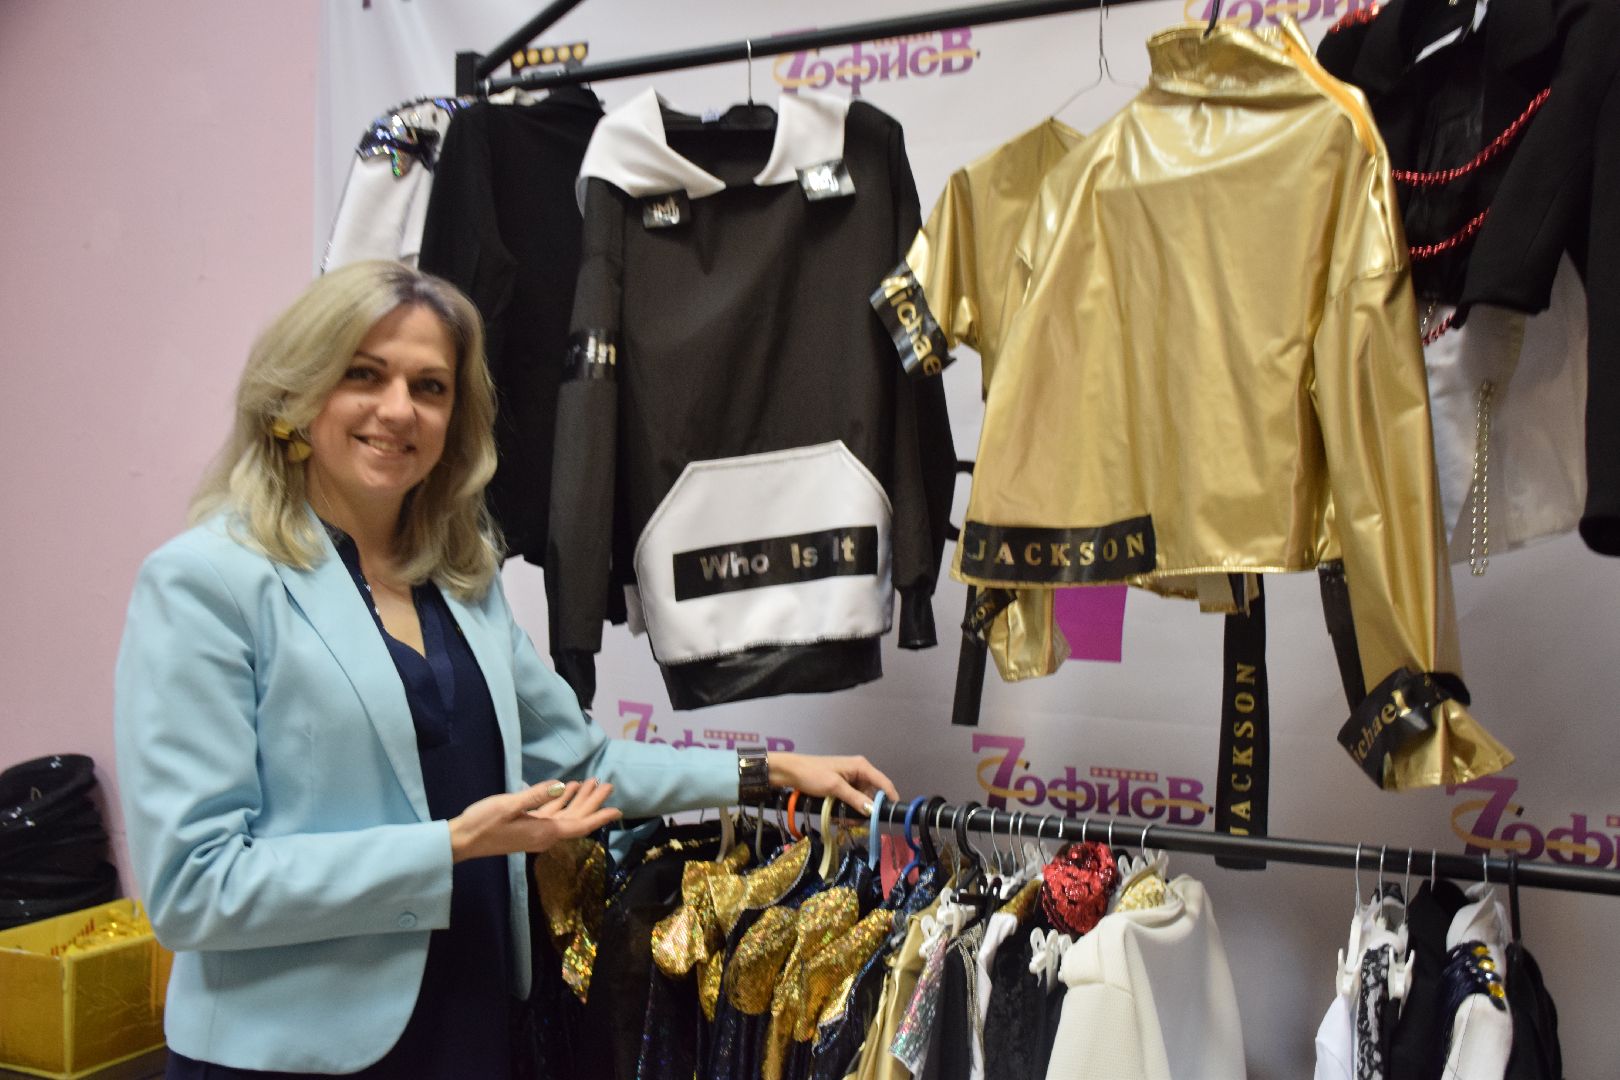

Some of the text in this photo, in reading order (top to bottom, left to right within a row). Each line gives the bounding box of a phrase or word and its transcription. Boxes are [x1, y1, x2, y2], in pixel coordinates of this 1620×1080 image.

[701, 536, 855, 581] Who Is It
[969, 532, 1146, 567] JACKSON
